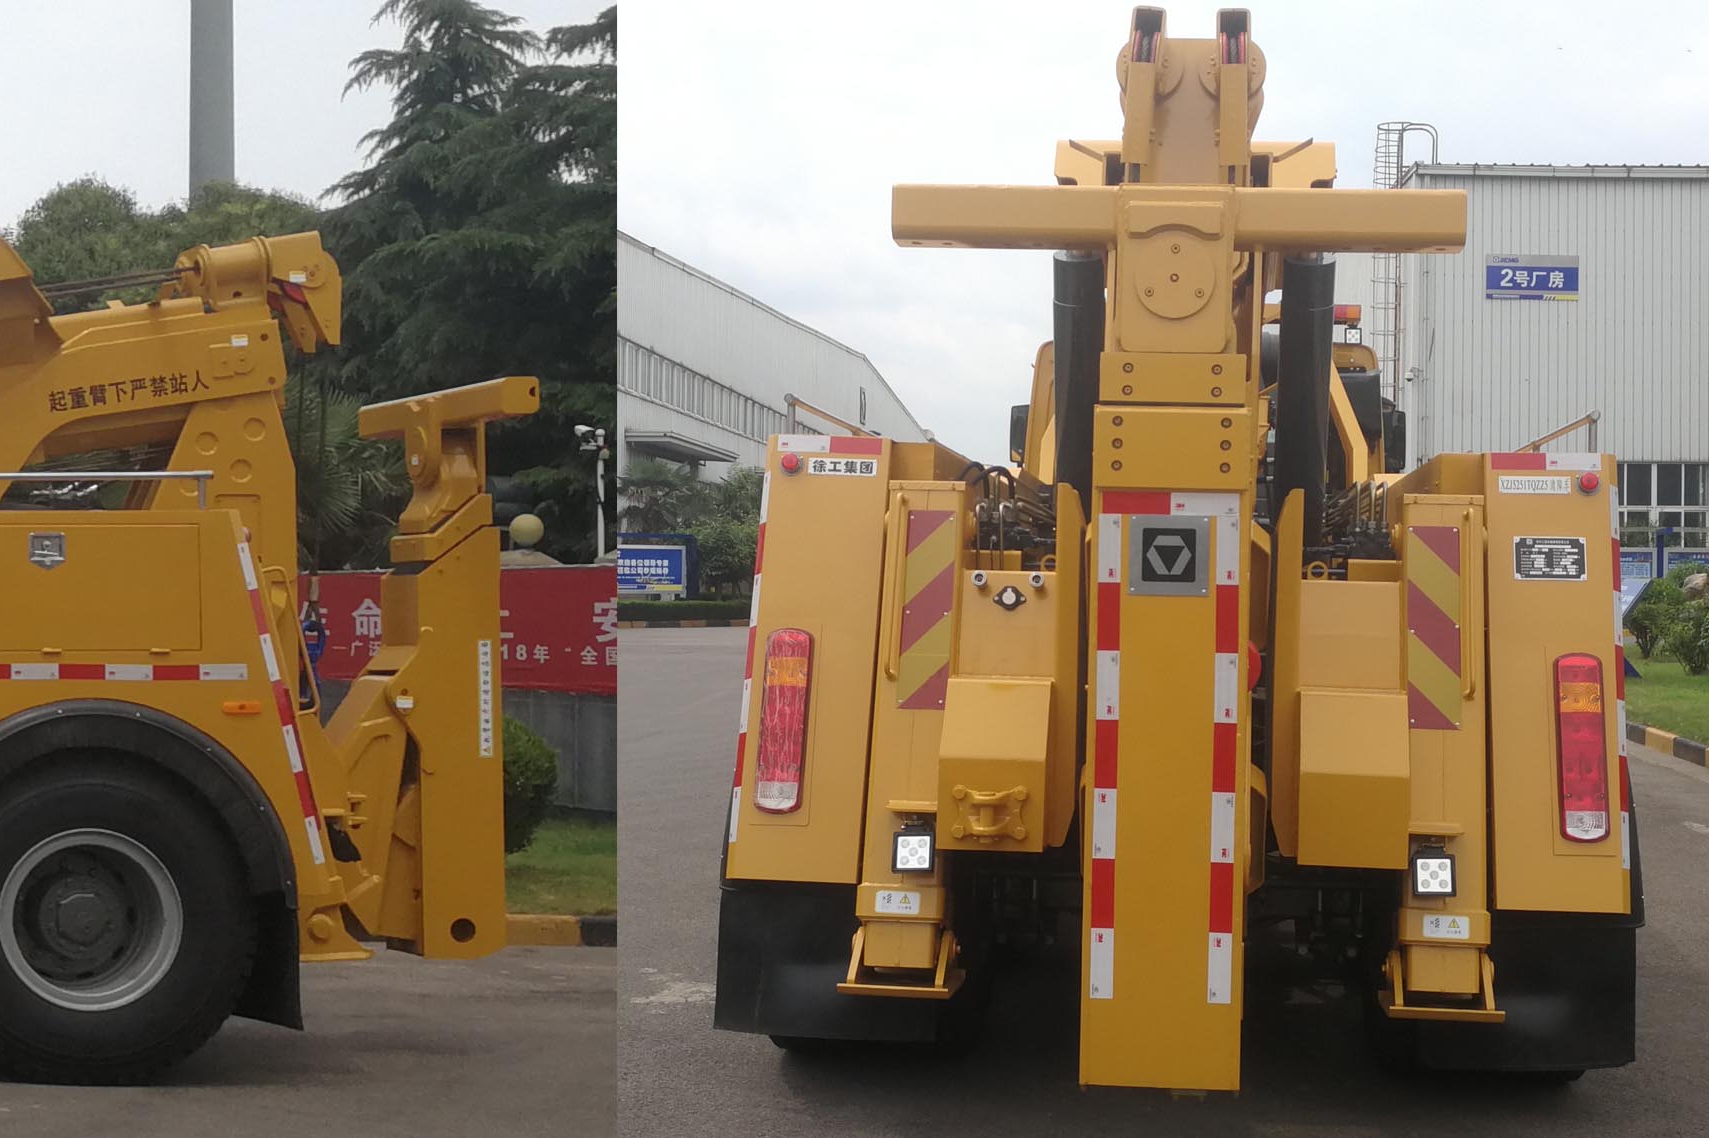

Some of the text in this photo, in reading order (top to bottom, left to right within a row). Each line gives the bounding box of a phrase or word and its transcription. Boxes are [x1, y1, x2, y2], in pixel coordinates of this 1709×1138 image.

[1500, 268, 1564, 288] 2号厂房
[48, 370, 209, 413] 起重臂下严禁站人
[812, 460, 873, 474] 徐工集团
